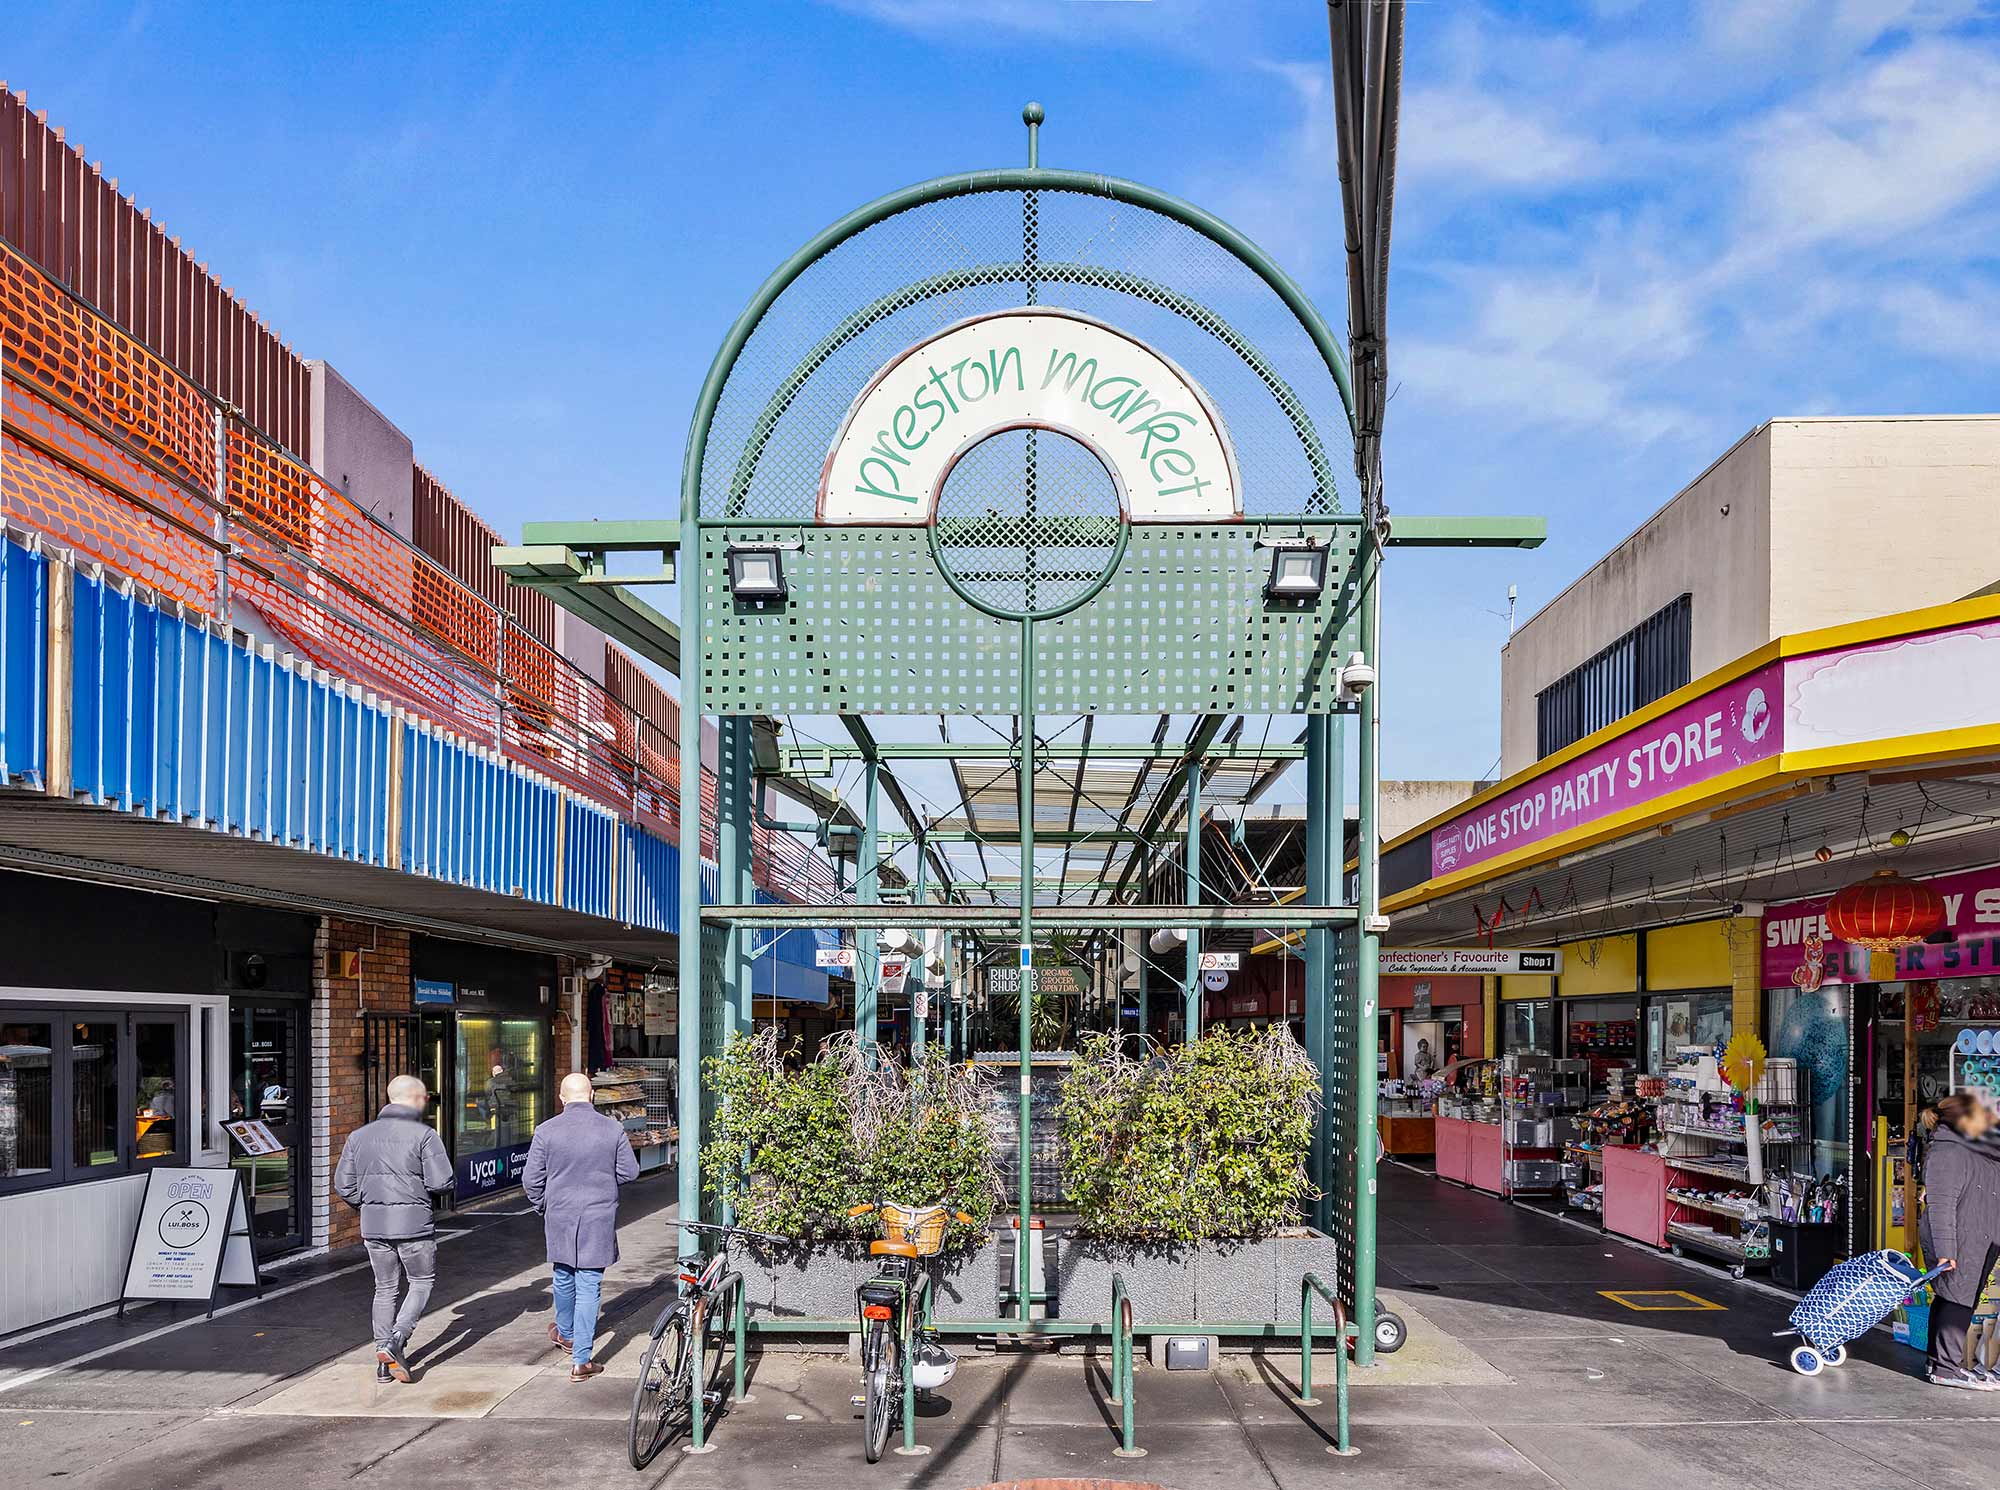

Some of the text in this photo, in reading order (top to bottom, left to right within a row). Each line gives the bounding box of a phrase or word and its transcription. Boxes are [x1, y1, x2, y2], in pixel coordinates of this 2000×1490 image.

[855, 346, 1212, 504] preston market
[1464, 711, 1722, 853] ONE STOP PARTY STORE
[1440, 846, 1457, 858] SUPPLIES
[1766, 914, 1832, 948] SWEE
[1378, 951, 1509, 963] onfectioner's Favourite
[1523, 956, 1551, 967] Shop 1
[1826, 946, 1925, 977] SUR
[1217, 961, 1238, 969] SMOKING
[1388, 964, 1497, 974] Cake Ingredients & Accessories
[991, 968, 1038, 980] RHUBB
[991, 981, 1038, 992] RHUBB
[511, 1152, 529, 1163] Connec
[470, 1160, 496, 1184] Lyca
[511, 1166, 522, 1179] your
[481, 1177, 496, 1188] Mobile
[168, 1183, 213, 1200] OPEN
